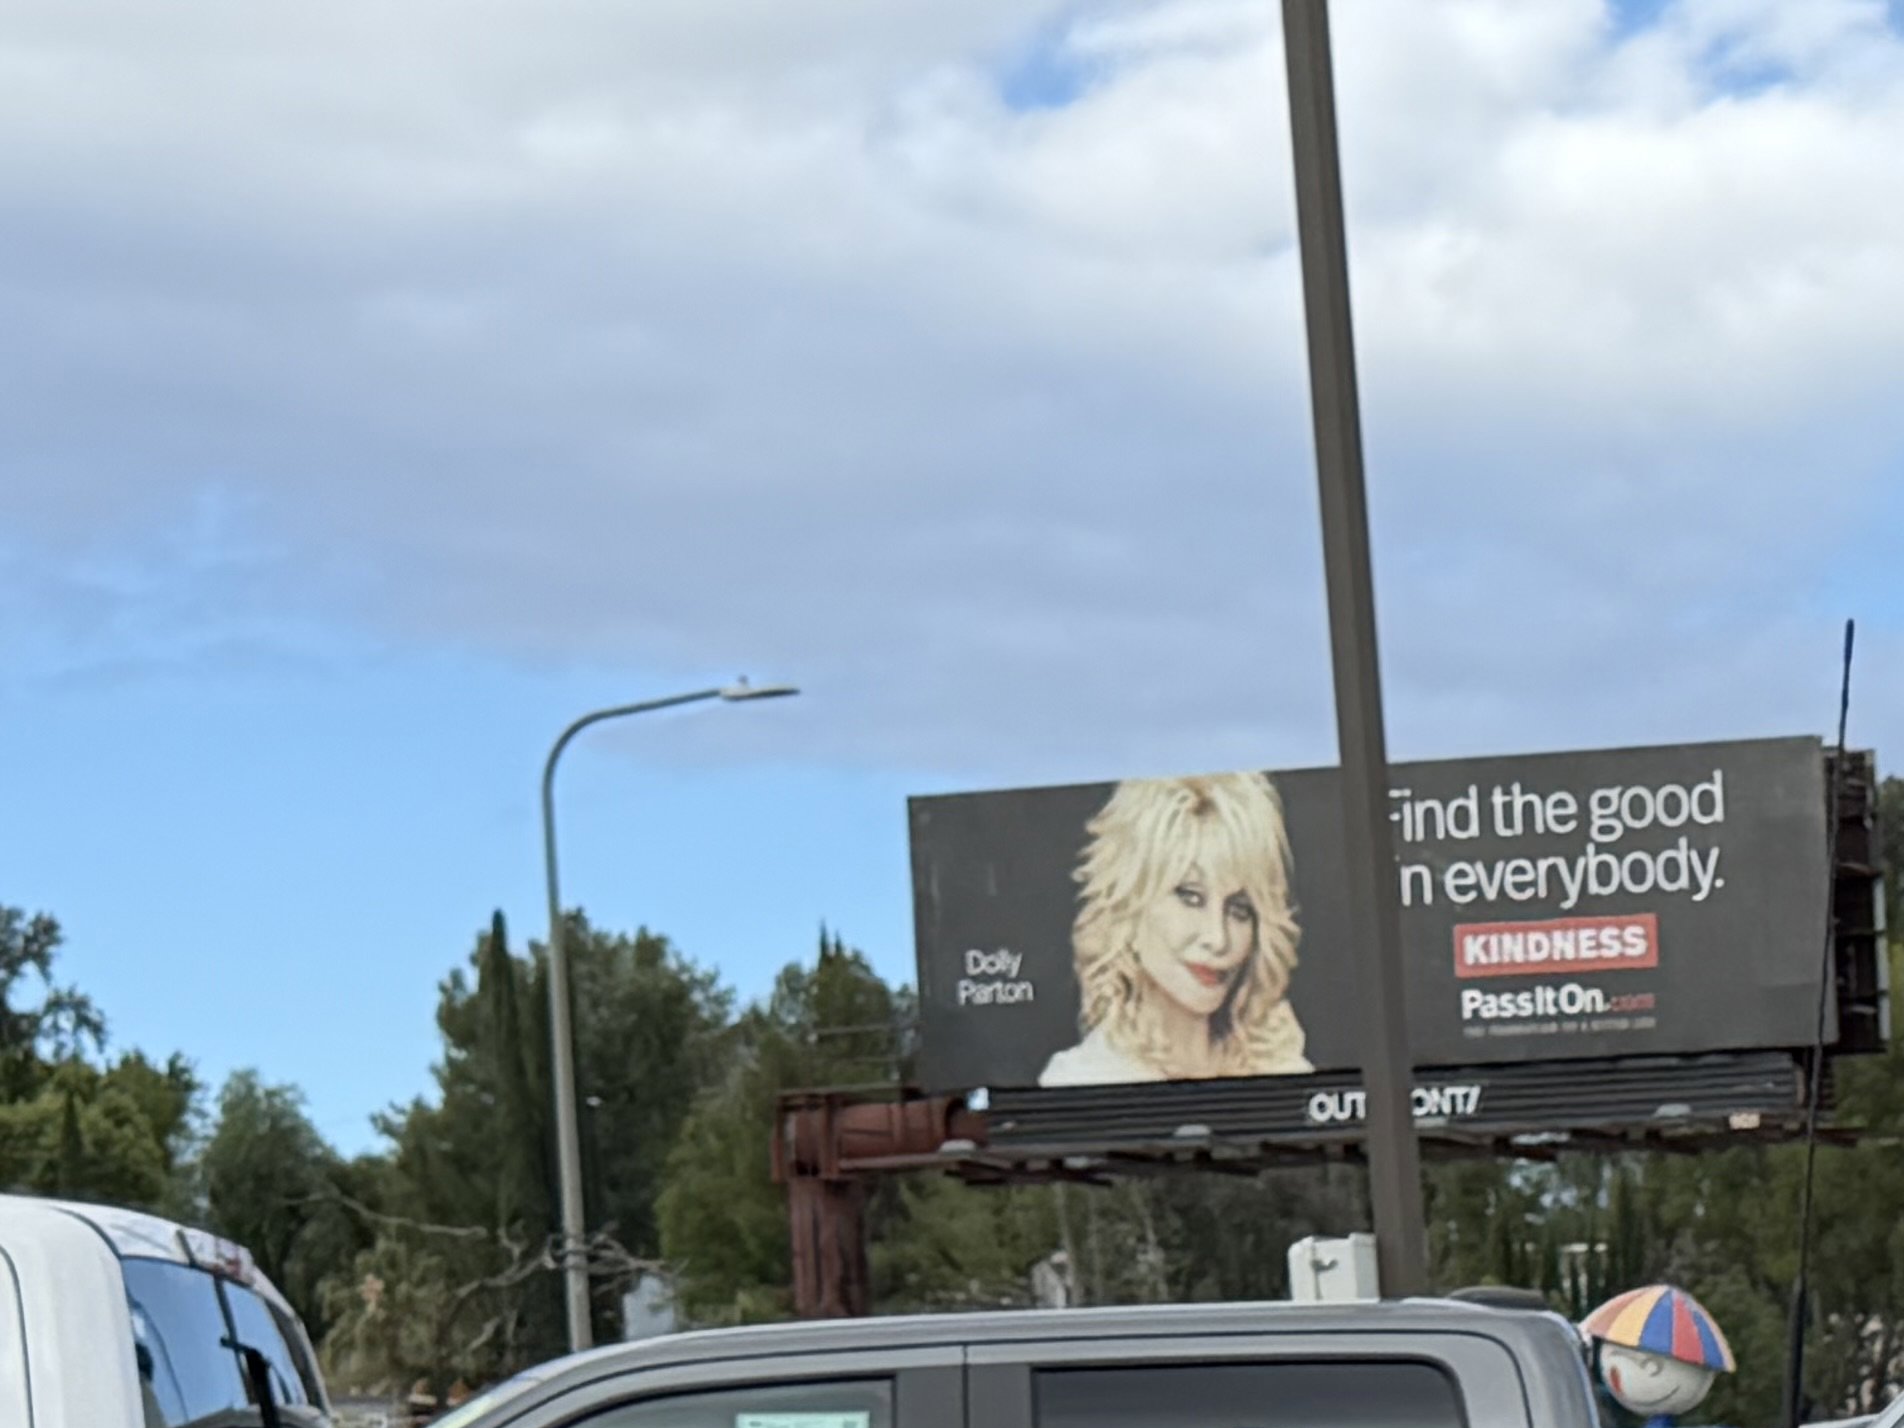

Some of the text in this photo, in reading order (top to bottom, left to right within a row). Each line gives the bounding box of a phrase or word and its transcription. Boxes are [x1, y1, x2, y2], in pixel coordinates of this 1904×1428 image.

[1388, 769, 1725, 842] ind the good
[1396, 836, 1725, 910] n everybody.
[966, 948, 1022, 978] Dolly
[1463, 930, 1647, 967] KINDNESS
[957, 976, 1034, 1005] Parton
